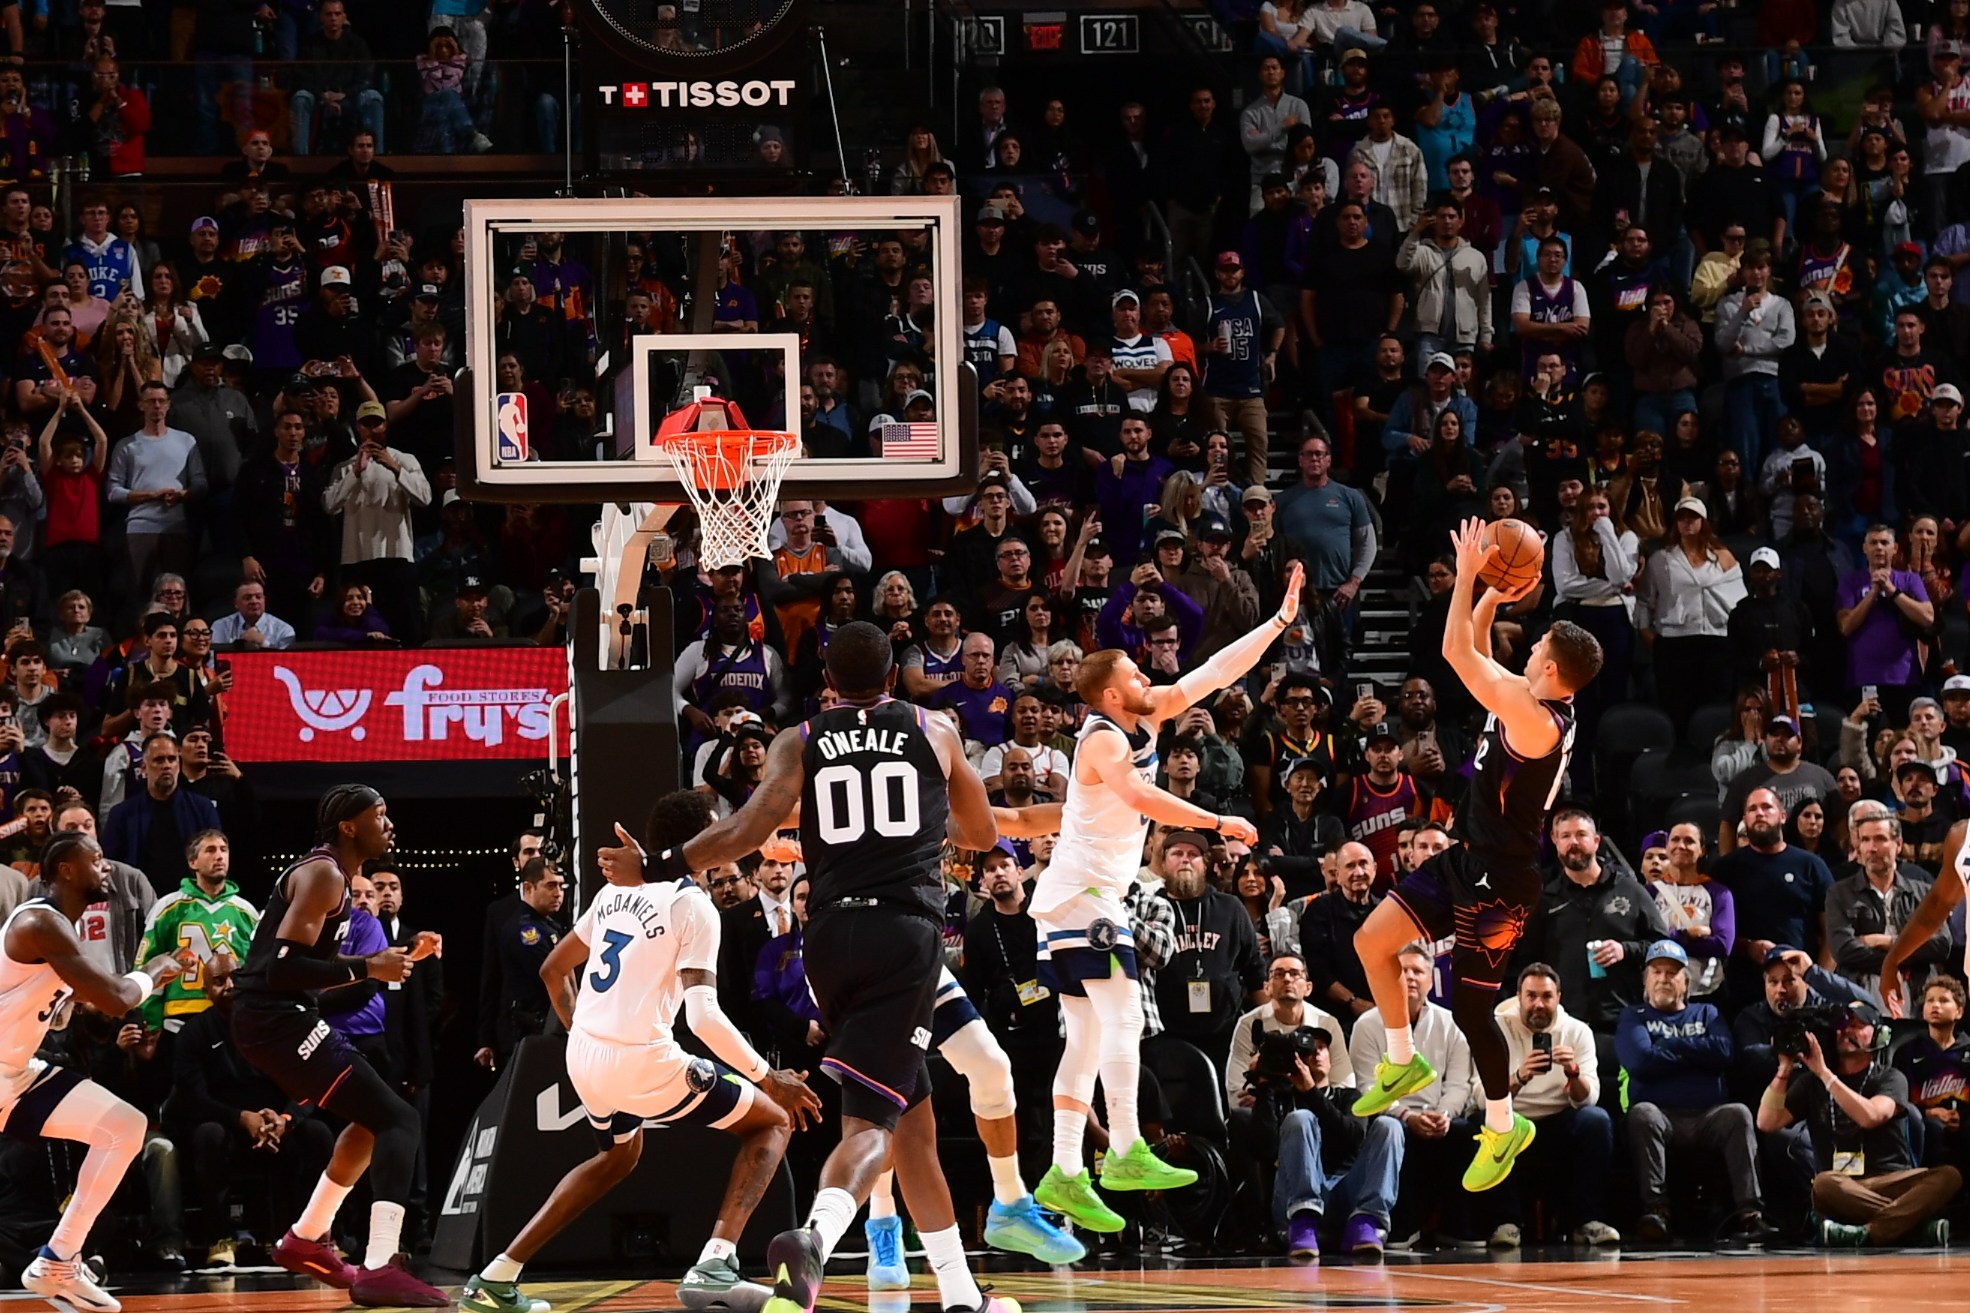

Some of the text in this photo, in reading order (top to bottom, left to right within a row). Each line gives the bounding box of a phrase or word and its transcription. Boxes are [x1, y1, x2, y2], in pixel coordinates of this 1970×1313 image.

[1091, 20, 1128, 47] 121
[599, 80, 797, 107] T TISSOT
[88, 267, 120, 286] UKE
[1229, 317, 1254, 337] SA
[1114, 357, 1157, 370] WOLVES
[1883, 364, 1936, 399] SUNS
[501, 446, 517, 458] NBA
[384, 663, 553, 748] fry's
[427, 690, 542, 704] FOOD STORES
[817, 729, 909, 761] O'NEALE
[813, 760, 921, 846] 00
[596, 893, 666, 941] McDANIELS
[590, 927, 635, 993] 3
[1919, 1073, 1968, 1102] Valley
